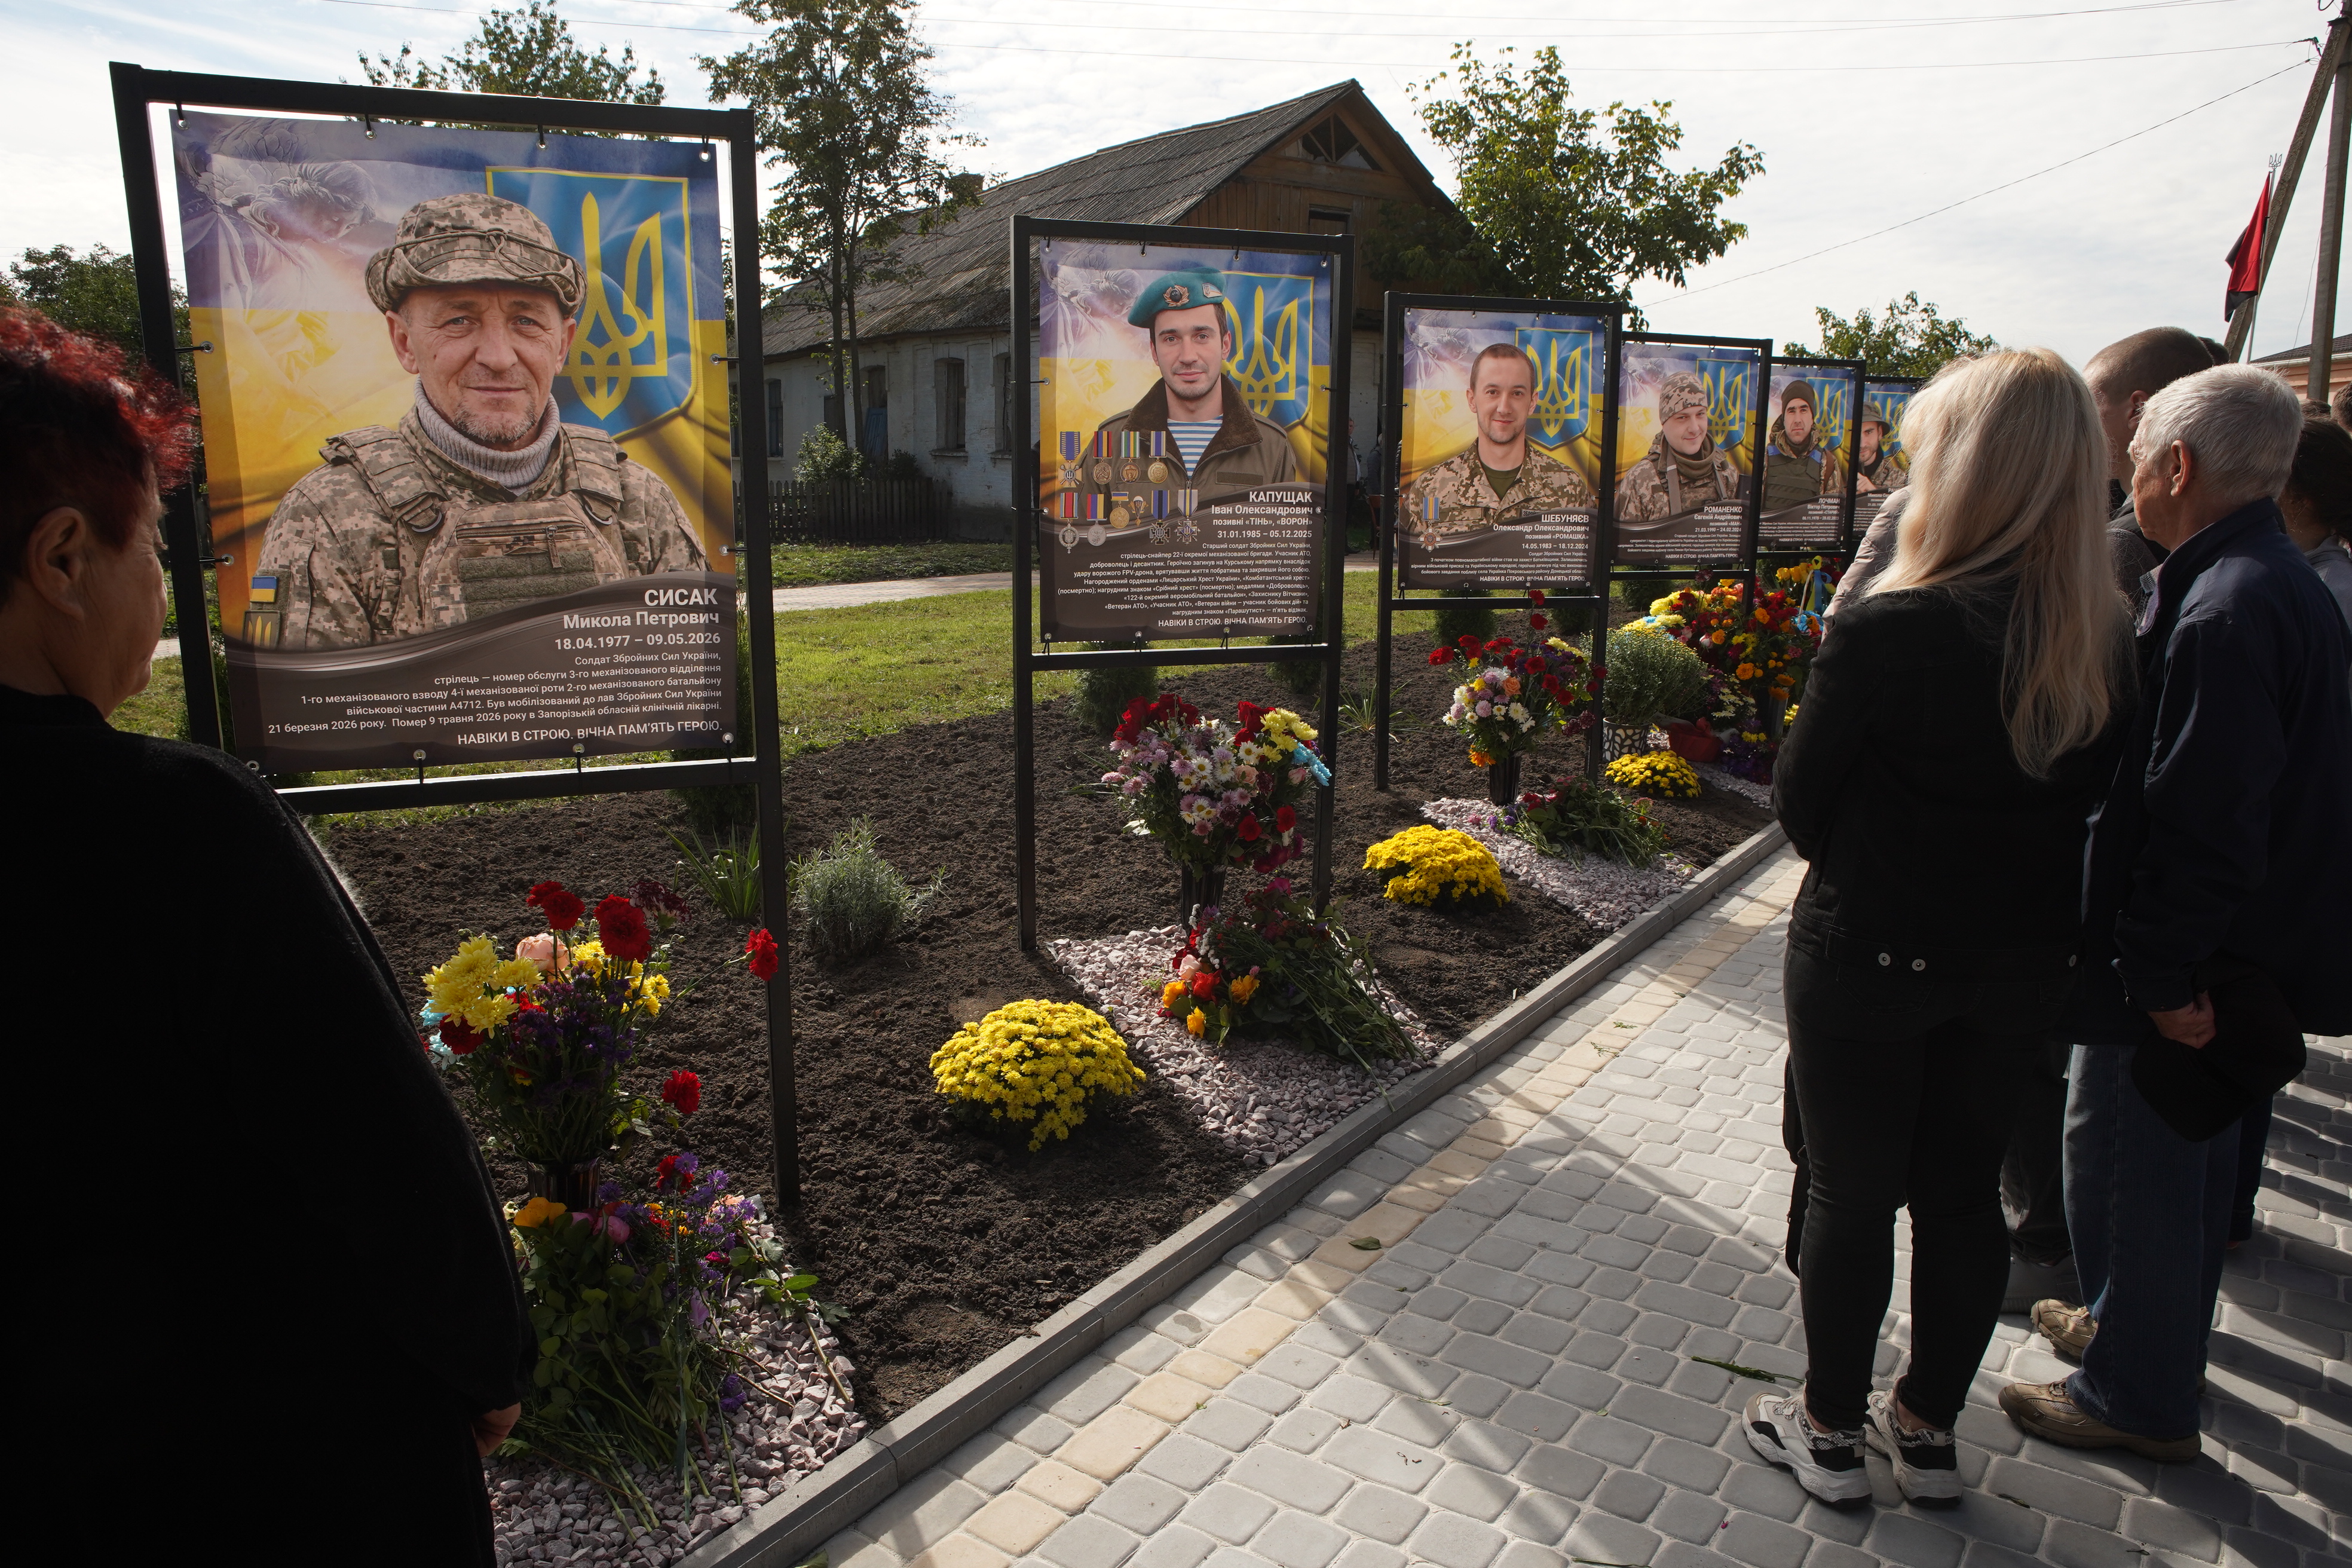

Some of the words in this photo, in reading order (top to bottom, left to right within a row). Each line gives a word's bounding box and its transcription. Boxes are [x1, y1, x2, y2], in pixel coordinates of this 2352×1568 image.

[1250, 491, 1312, 504] КАПУЩАК
[1211, 505, 1233, 514] Іван
[1235, 505, 1313, 516] Олександрович
[1245, 517, 1275, 526] «ТІНЬ»,
[645, 589, 718, 605] СИСАК
[564, 615, 631, 628] Микола
[636, 612, 719, 627] Петрович
[555, 635, 630, 650] 18.04.1977
[647, 633, 721, 645] 09.05.2026
[575, 657, 611, 665] Солдат
[613, 653, 659, 663] Збройних
[682, 651, 721, 661] України,
[434, 675, 479, 685] стрілець
[528, 671, 566, 681] обслуги
[592, 667, 667, 676] механізованого
[670, 664, 721, 673] відділення
[326, 693, 409, 702] механізованого
[412, 691, 448, 699] взводу
[451, 688, 464, 696] 4-ї
[467, 685, 539, 696] механізованої
[541, 685, 564, 694] роти
[589, 680, 664, 690] механізованого
[667, 676, 721, 686] батальйону
[347, 705, 403, 715] військової
[405, 705, 447, 713] частини
[487, 700, 505, 709] Був
[508, 696, 580, 706] мобілізований
[583, 697, 595, 705] до
[617, 692, 662, 702] Збройних
[685, 689, 721, 699] України
[268, 725, 280, 733] 21
[284, 724, 328, 733] березня
[331, 720, 357, 730] 2026
[360, 721, 386, 730] року.
[392, 718, 427, 728] Помер
[429, 716, 435, 725] 9
[437, 716, 473, 725] травня
[476, 712, 501, 721] 2026
[503, 713, 526, 722] року
[538, 708, 595, 719] Запорізькій
[598, 705, 639, 715] обласній
[642, 703, 684, 712] клінічній
[687, 702, 721, 711] лікарні.
[458, 732, 507, 744] НАВІКИ
[512, 731, 520, 741] В
[523, 729, 573, 740] СТРОЮ.
[577, 726, 615, 739] ВІЧНА
[678, 721, 722, 731] ГЕРОЮ.
